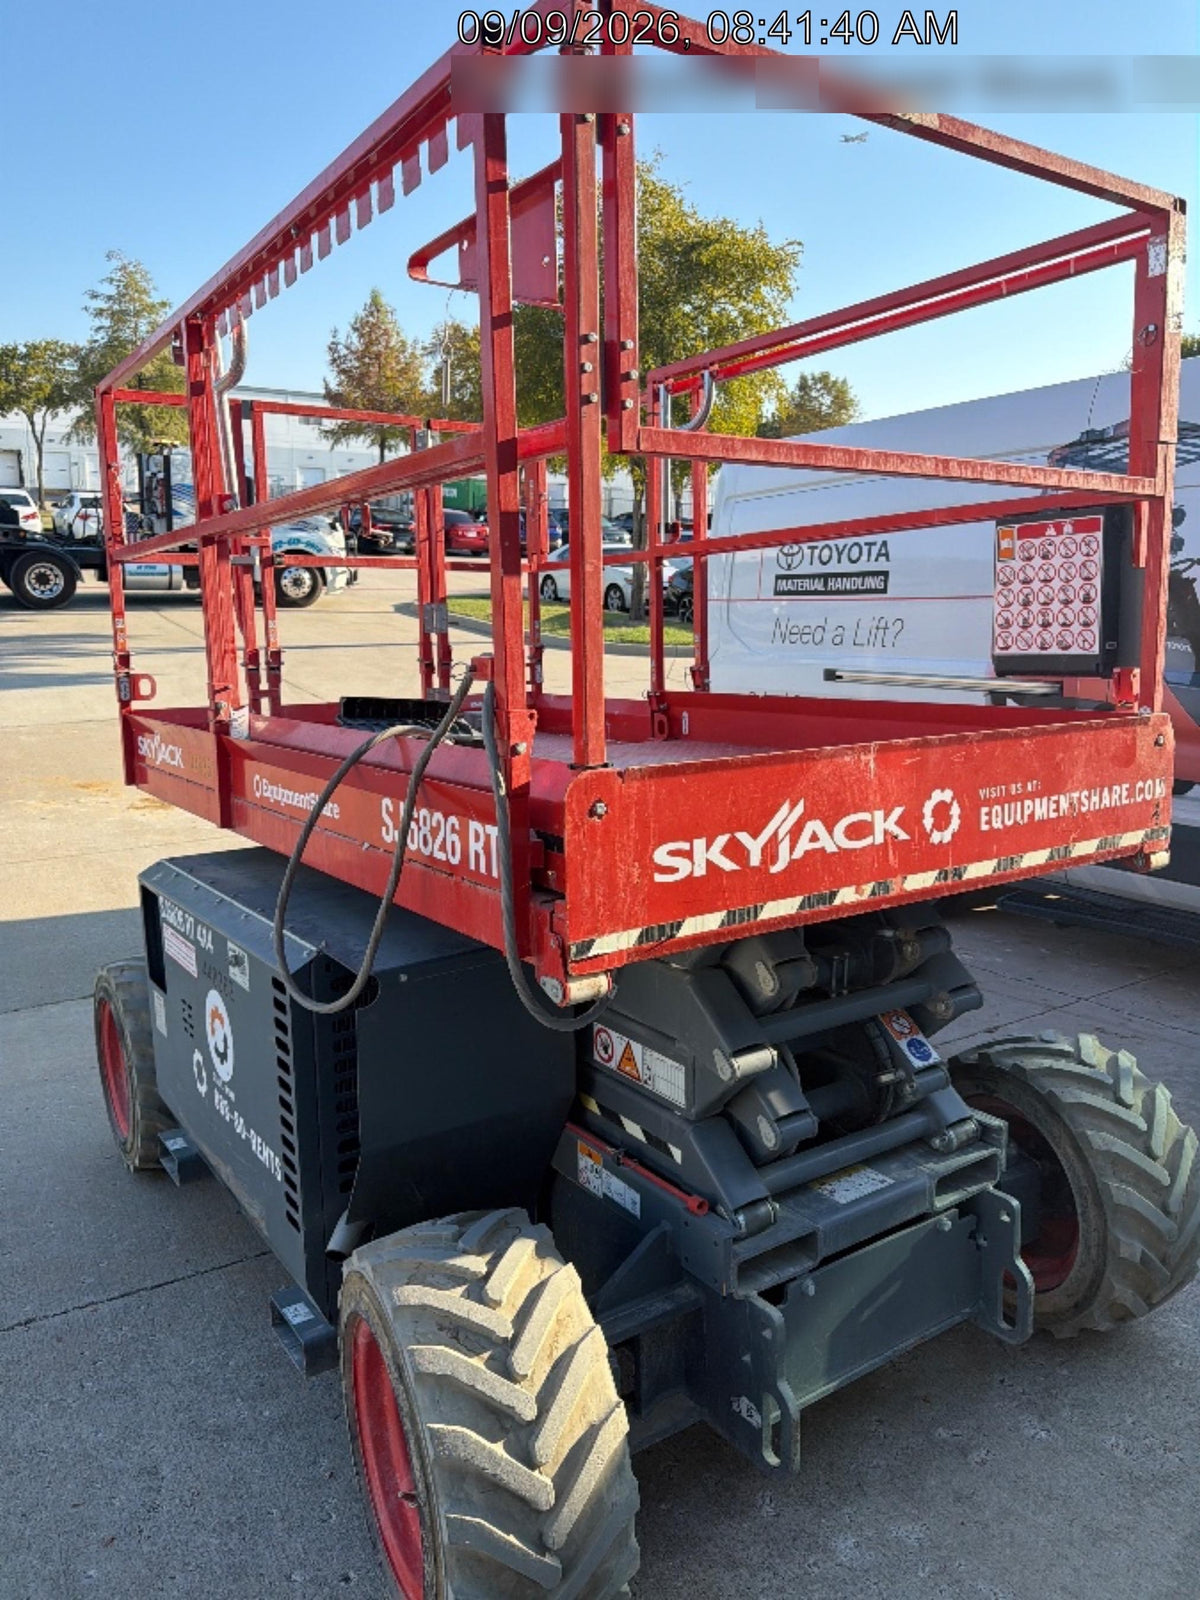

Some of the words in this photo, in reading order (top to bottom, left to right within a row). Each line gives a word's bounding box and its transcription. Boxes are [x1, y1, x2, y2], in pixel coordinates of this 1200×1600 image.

[807, 540, 891, 566] TOYOTA
[776, 577, 826, 592] MATERIAL
[827, 575, 885, 591] HANDLING
[771, 617, 827, 646] Need
[831, 625, 846, 647] a
[853, 616, 905, 648] Lift?
[137, 730, 185, 768] SKYJACK
[262, 777, 340, 819] EquipmentSare
[978, 785, 1007, 801] VISIT
[1010, 784, 1022, 796] US
[1027, 780, 1042, 793] AT:
[979, 776, 1167, 831] EQUIPMENTSHARE.COM
[468, 819, 499, 879] RT
[652, 797, 912, 883] SKYJACK
